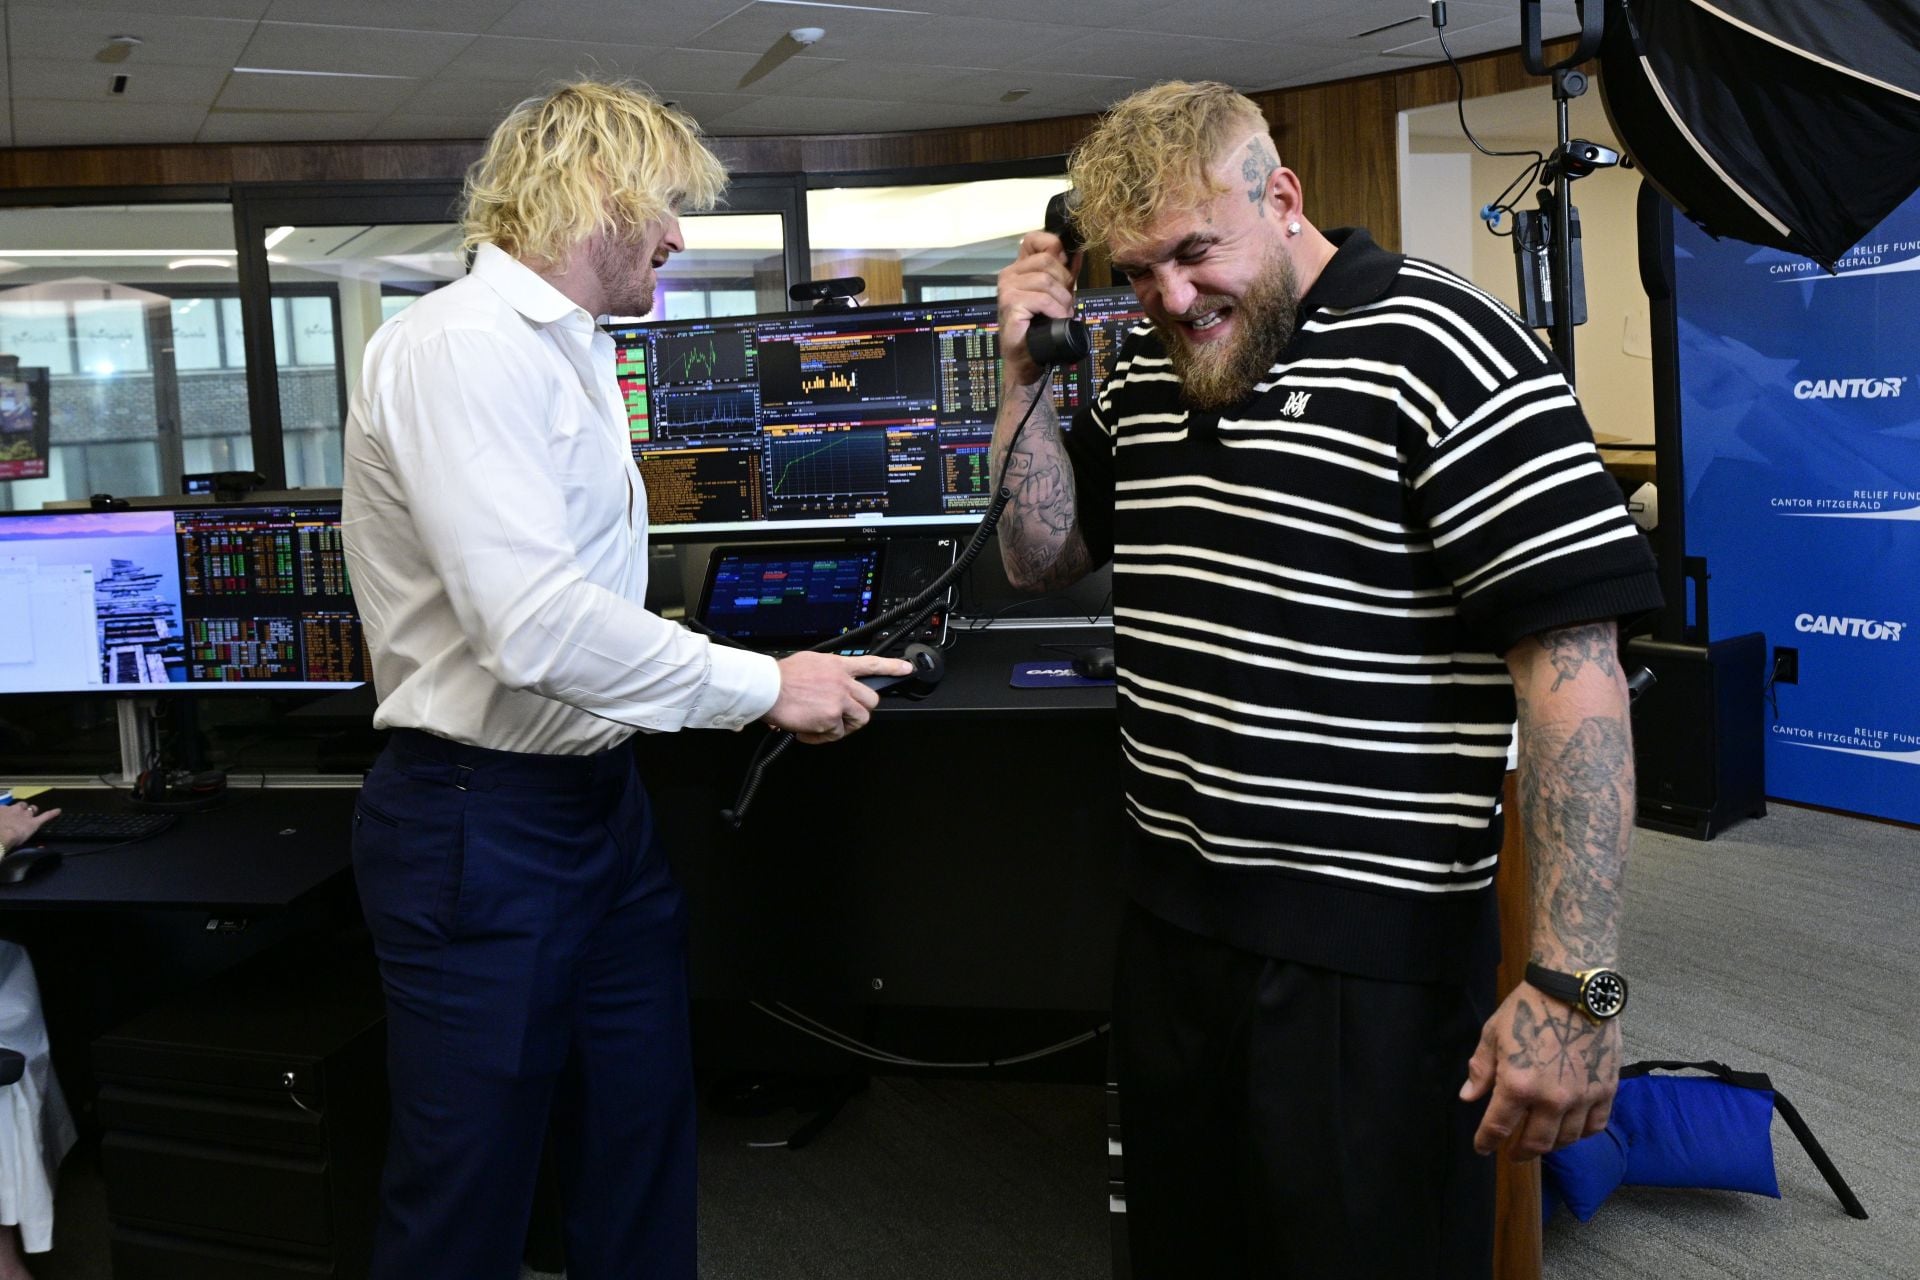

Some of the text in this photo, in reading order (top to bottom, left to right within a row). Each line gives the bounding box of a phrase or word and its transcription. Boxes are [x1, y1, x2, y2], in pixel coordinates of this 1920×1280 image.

[1853, 243, 1889, 255] RELIEF
[1769, 262, 1812, 274] CANTOR
[1793, 377, 1902, 400] CANTOR
[1853, 490, 1889, 500] RELIEF
[1770, 498, 1881, 510] CANTOR FITZGERALD
[1794, 613, 1902, 641] CANTOR
[1772, 725, 1881, 749] CANTOR FITZGERALD
[1854, 727, 1889, 740] RELIEF
